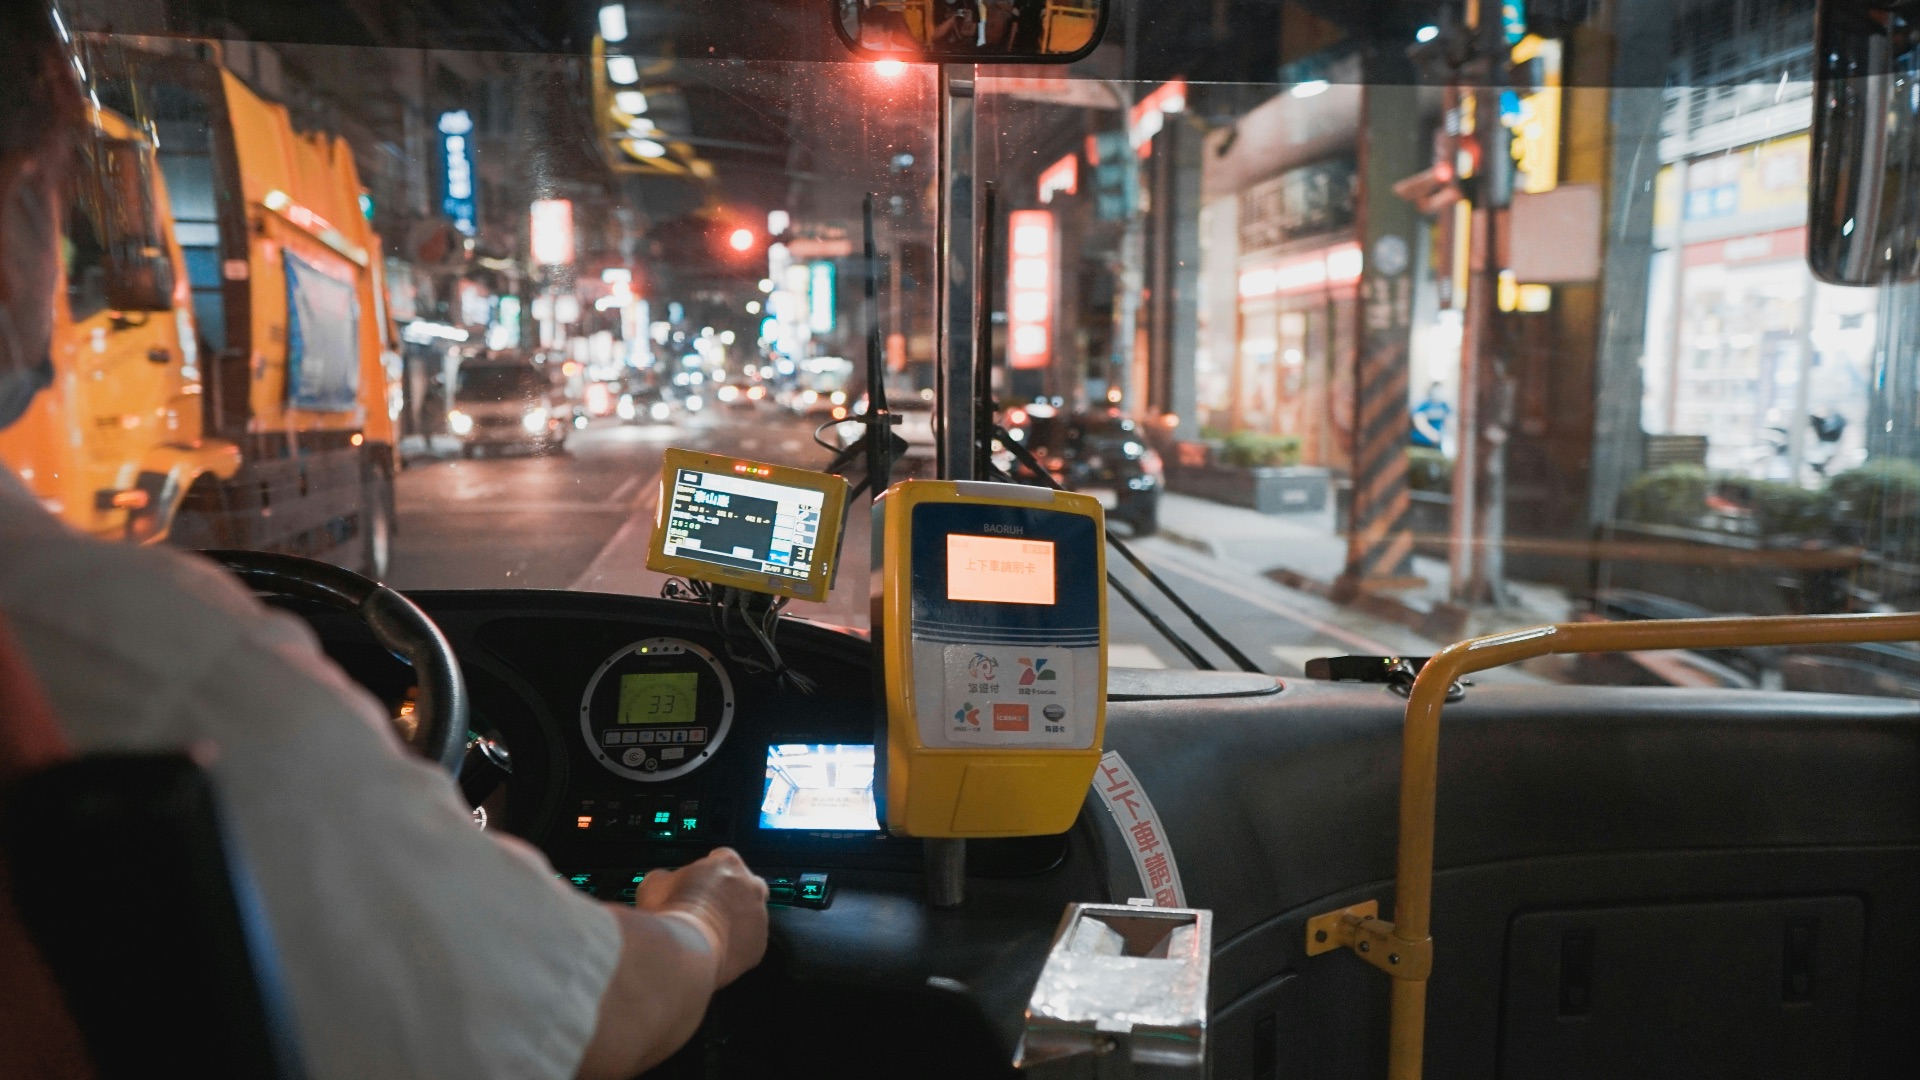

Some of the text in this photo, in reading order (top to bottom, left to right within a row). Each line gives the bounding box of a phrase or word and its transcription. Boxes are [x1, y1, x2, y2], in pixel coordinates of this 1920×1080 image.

[984, 523, 1024, 535] BAORUH
[964, 558, 1036, 575] 上下車請刷卡
[648, 695, 675, 714] 33
